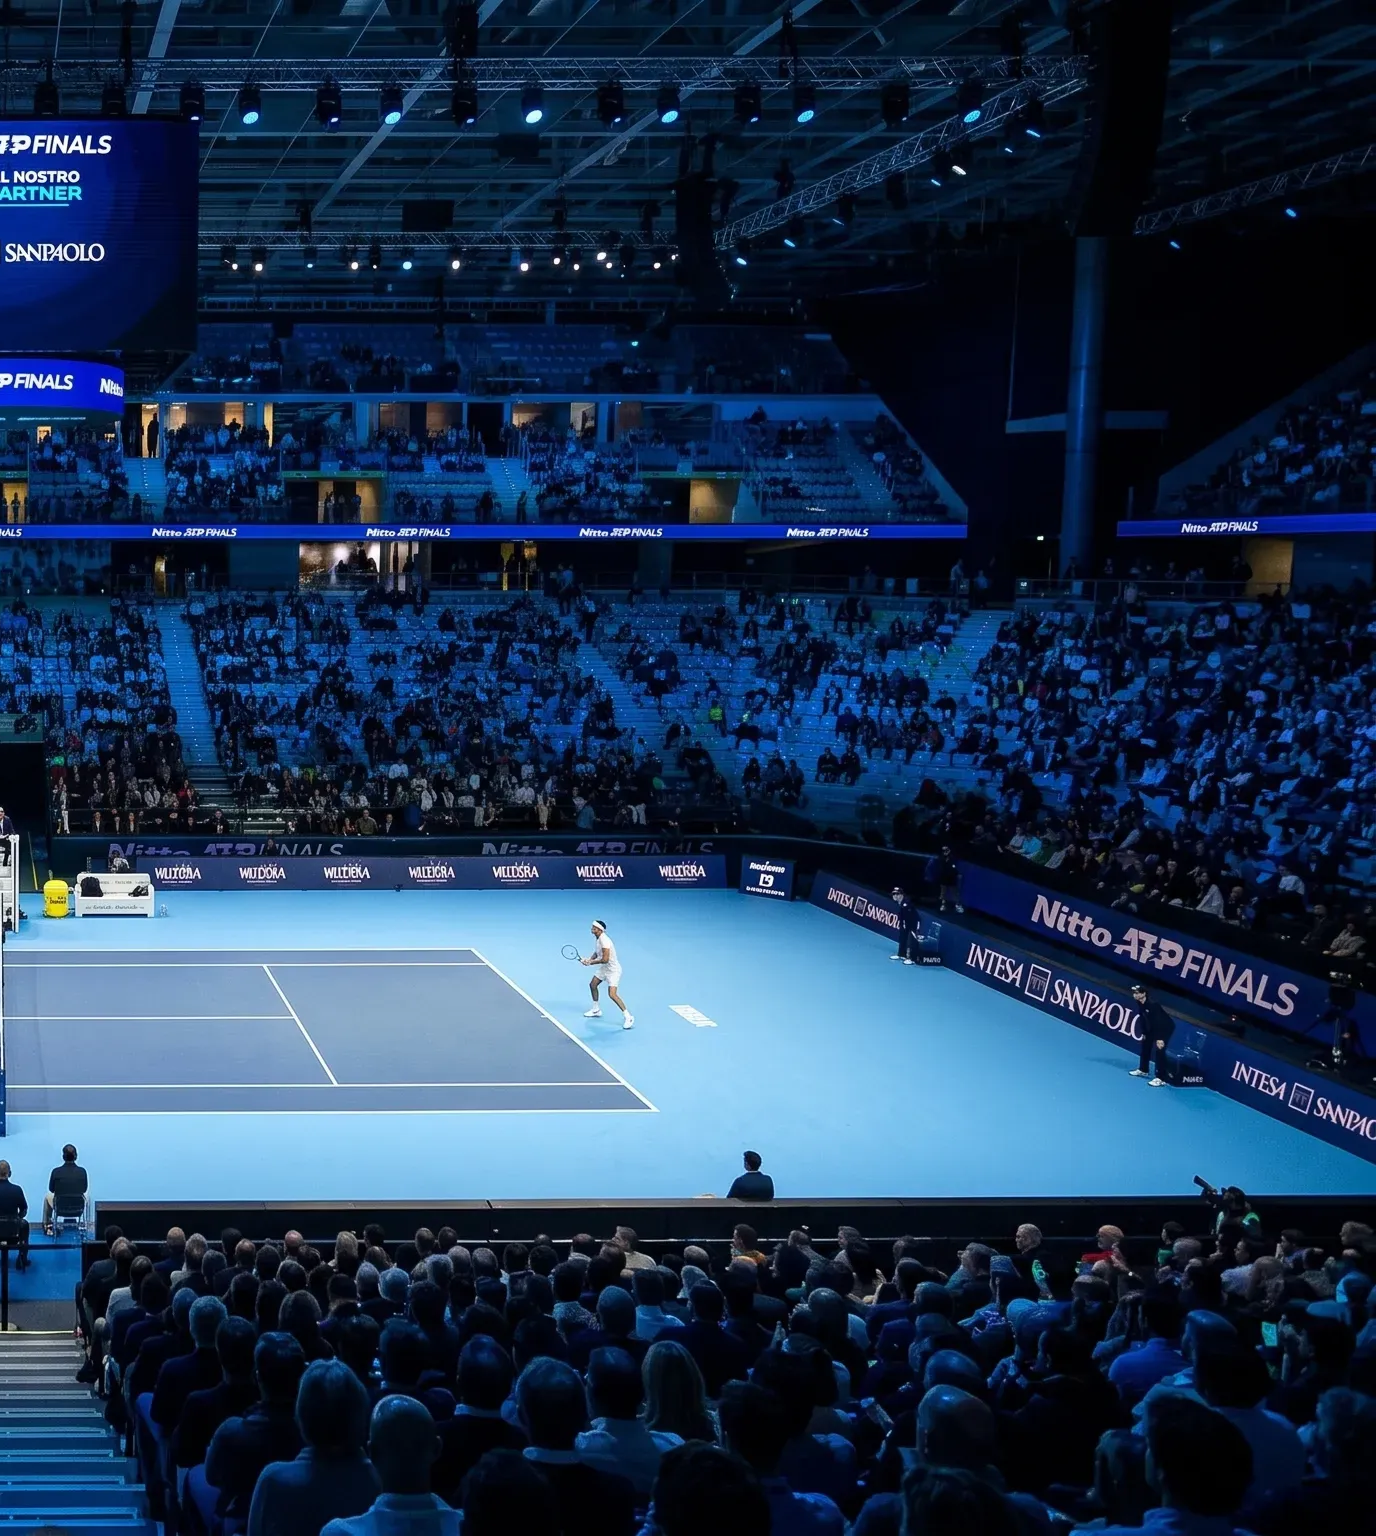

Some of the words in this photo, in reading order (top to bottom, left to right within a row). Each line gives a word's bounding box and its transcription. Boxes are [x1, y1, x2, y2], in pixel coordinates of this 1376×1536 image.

[32, 134, 112, 155] FINALS
[13, 170, 80, 184] NOSTRO
[5, 243, 105, 262] SANPAOLO
[13, 373, 74, 390] FINALS
[152, 528, 182, 537] Nitto
[1181, 523, 1207, 533] Nitto
[1031, 894, 1112, 948] Nitto
[1112, 927, 1184, 970] ATP
[1180, 949, 1300, 1016] FINALS
[966, 943, 1024, 988] INTESA
[1231, 1060, 1287, 1100] INTESA
[1313, 1097, 1376, 1141] SANPAO
